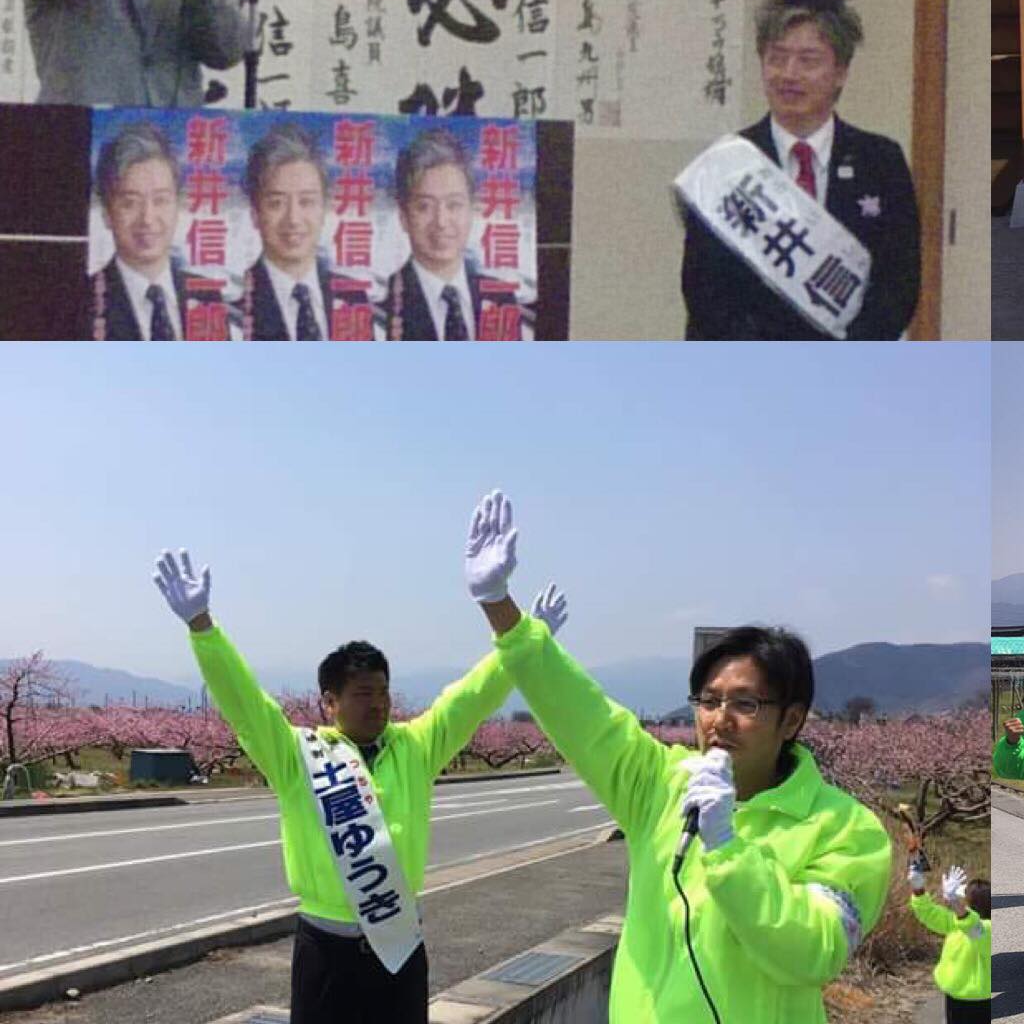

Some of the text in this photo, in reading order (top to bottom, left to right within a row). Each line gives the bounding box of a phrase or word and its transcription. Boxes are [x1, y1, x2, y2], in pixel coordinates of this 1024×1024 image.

[186, 116, 229, 341] 新井信一郎
[332, 119, 376, 341] 新井信一郎
[477, 124, 522, 341] 新井信一郎
[312, 761, 401, 925] 土屋ゆうき
